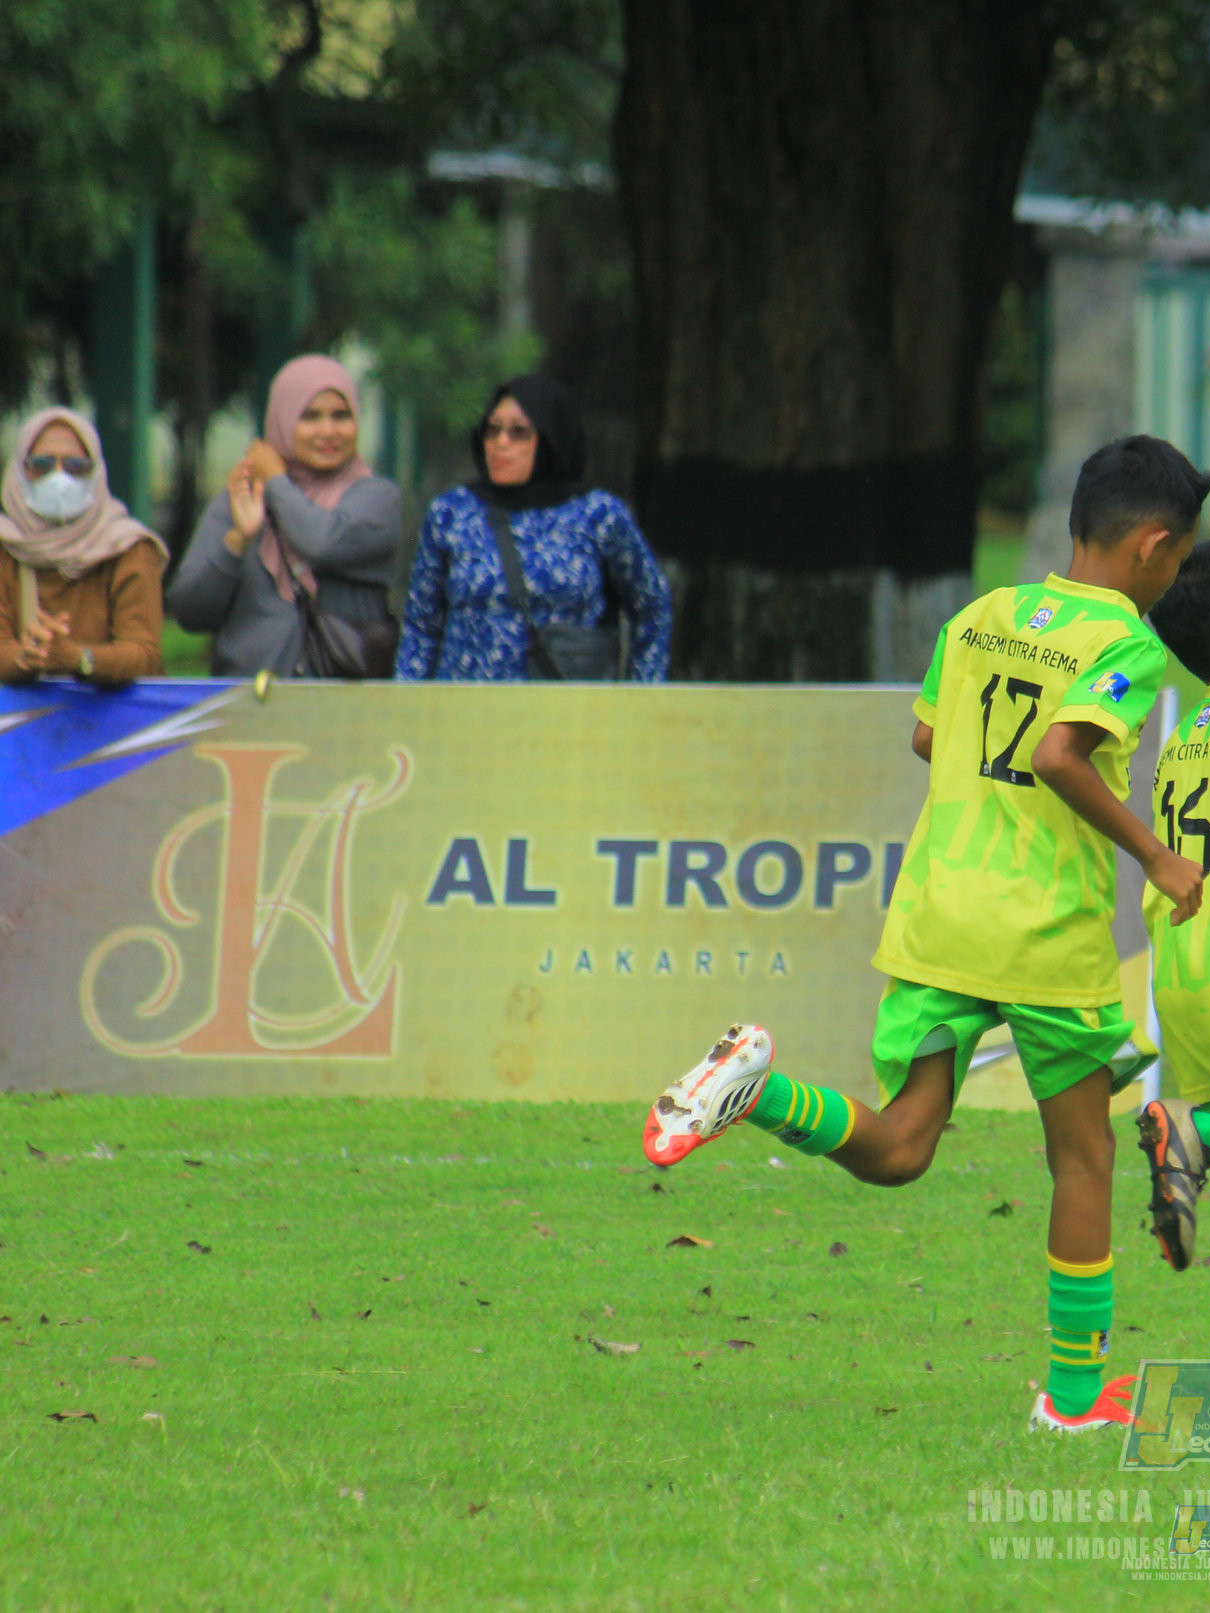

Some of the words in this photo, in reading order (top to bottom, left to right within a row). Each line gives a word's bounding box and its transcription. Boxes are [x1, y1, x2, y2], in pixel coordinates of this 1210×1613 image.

[1008, 639, 1038, 663] CITRA
[1040, 648, 1080, 676] REMA
[979, 673, 1044, 787] 12
[1178, 743, 1209, 761] CITRA
[425, 837, 558, 906] AL
[539, 948, 788, 975] JAKARTA
